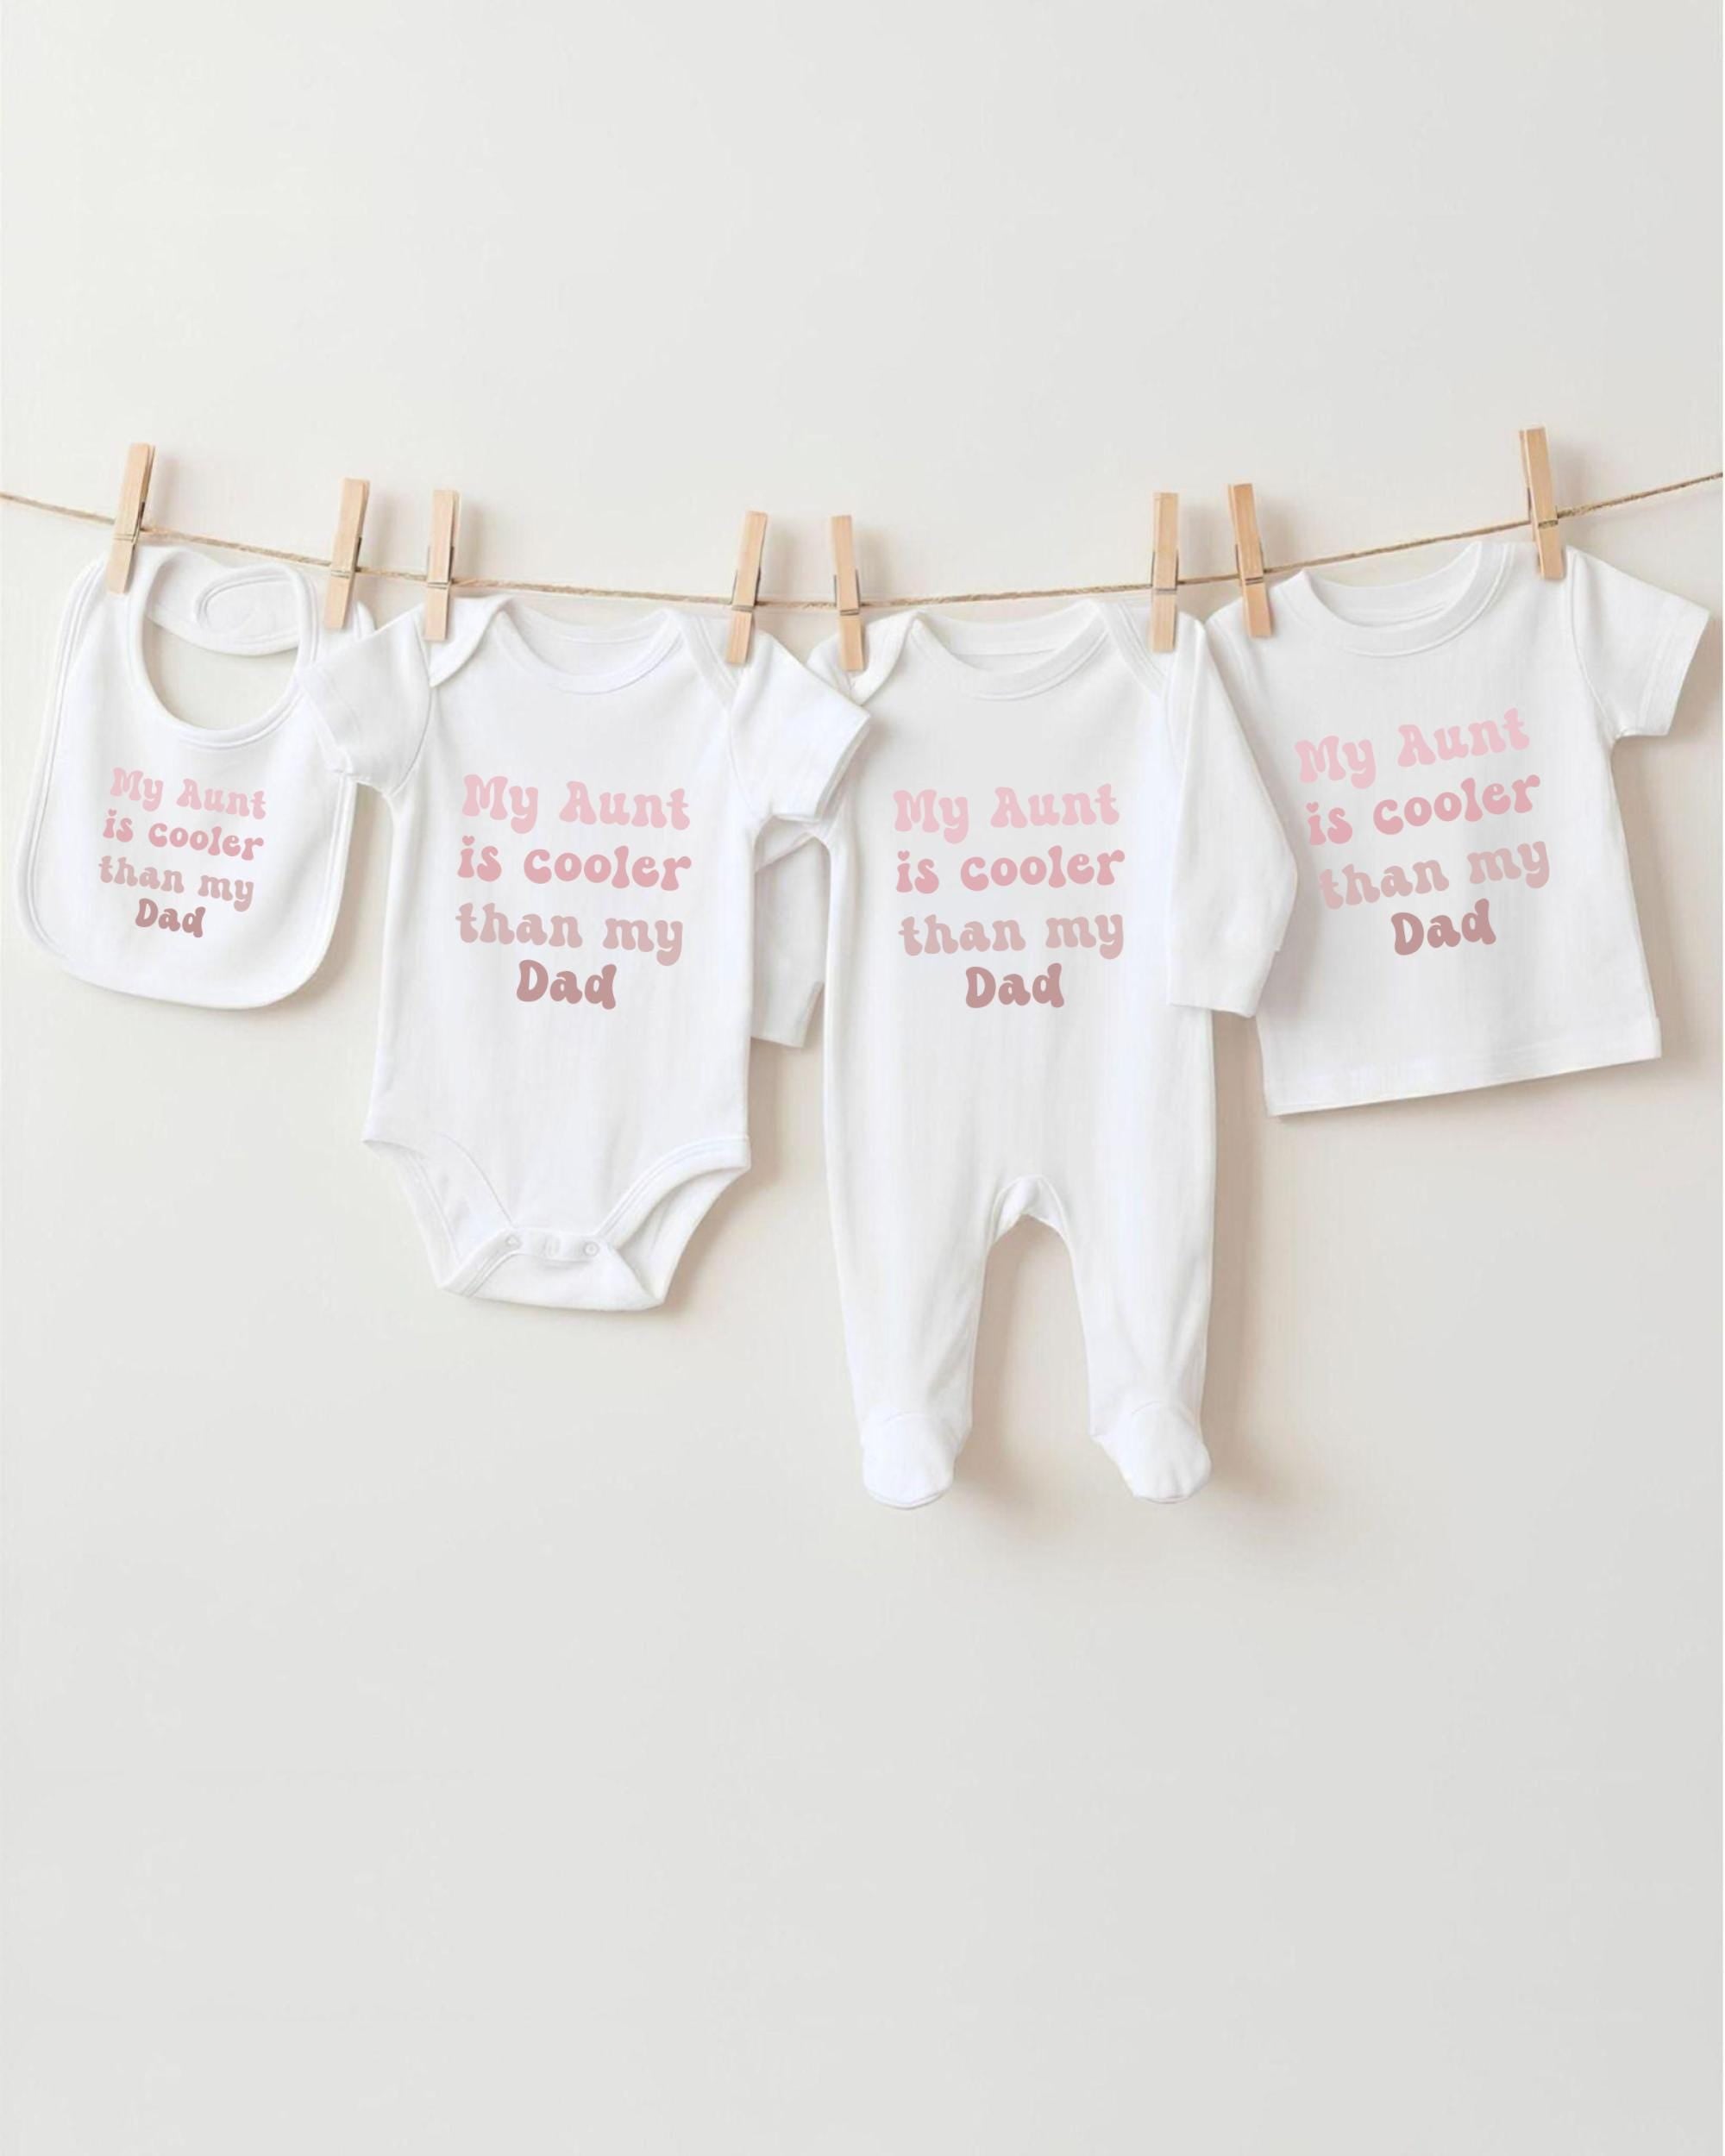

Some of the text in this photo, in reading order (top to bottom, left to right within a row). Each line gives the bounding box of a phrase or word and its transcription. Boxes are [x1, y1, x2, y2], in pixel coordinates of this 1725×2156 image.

[1294, 707, 1531, 790] My Aunt
[110, 767, 267, 820] My Aunt
[461, 774, 691, 834] My Aunt
[893, 783, 1120, 844] My Aunt
[1305, 774, 1541, 846] is cooler
[103, 808, 265, 862] is cooler
[457, 835, 693, 892] is cooler
[98, 855, 254, 912] than my
[895, 845, 1126, 894] is cooler
[1318, 841, 1551, 911] than my
[135, 898, 206, 938] Dad
[455, 902, 684, 966] than my
[898, 914, 1125, 960] than my
[1390, 898, 1496, 956] Dad
[516, 959, 618, 1011] Dad
[965, 962, 1065, 1009] Dad
